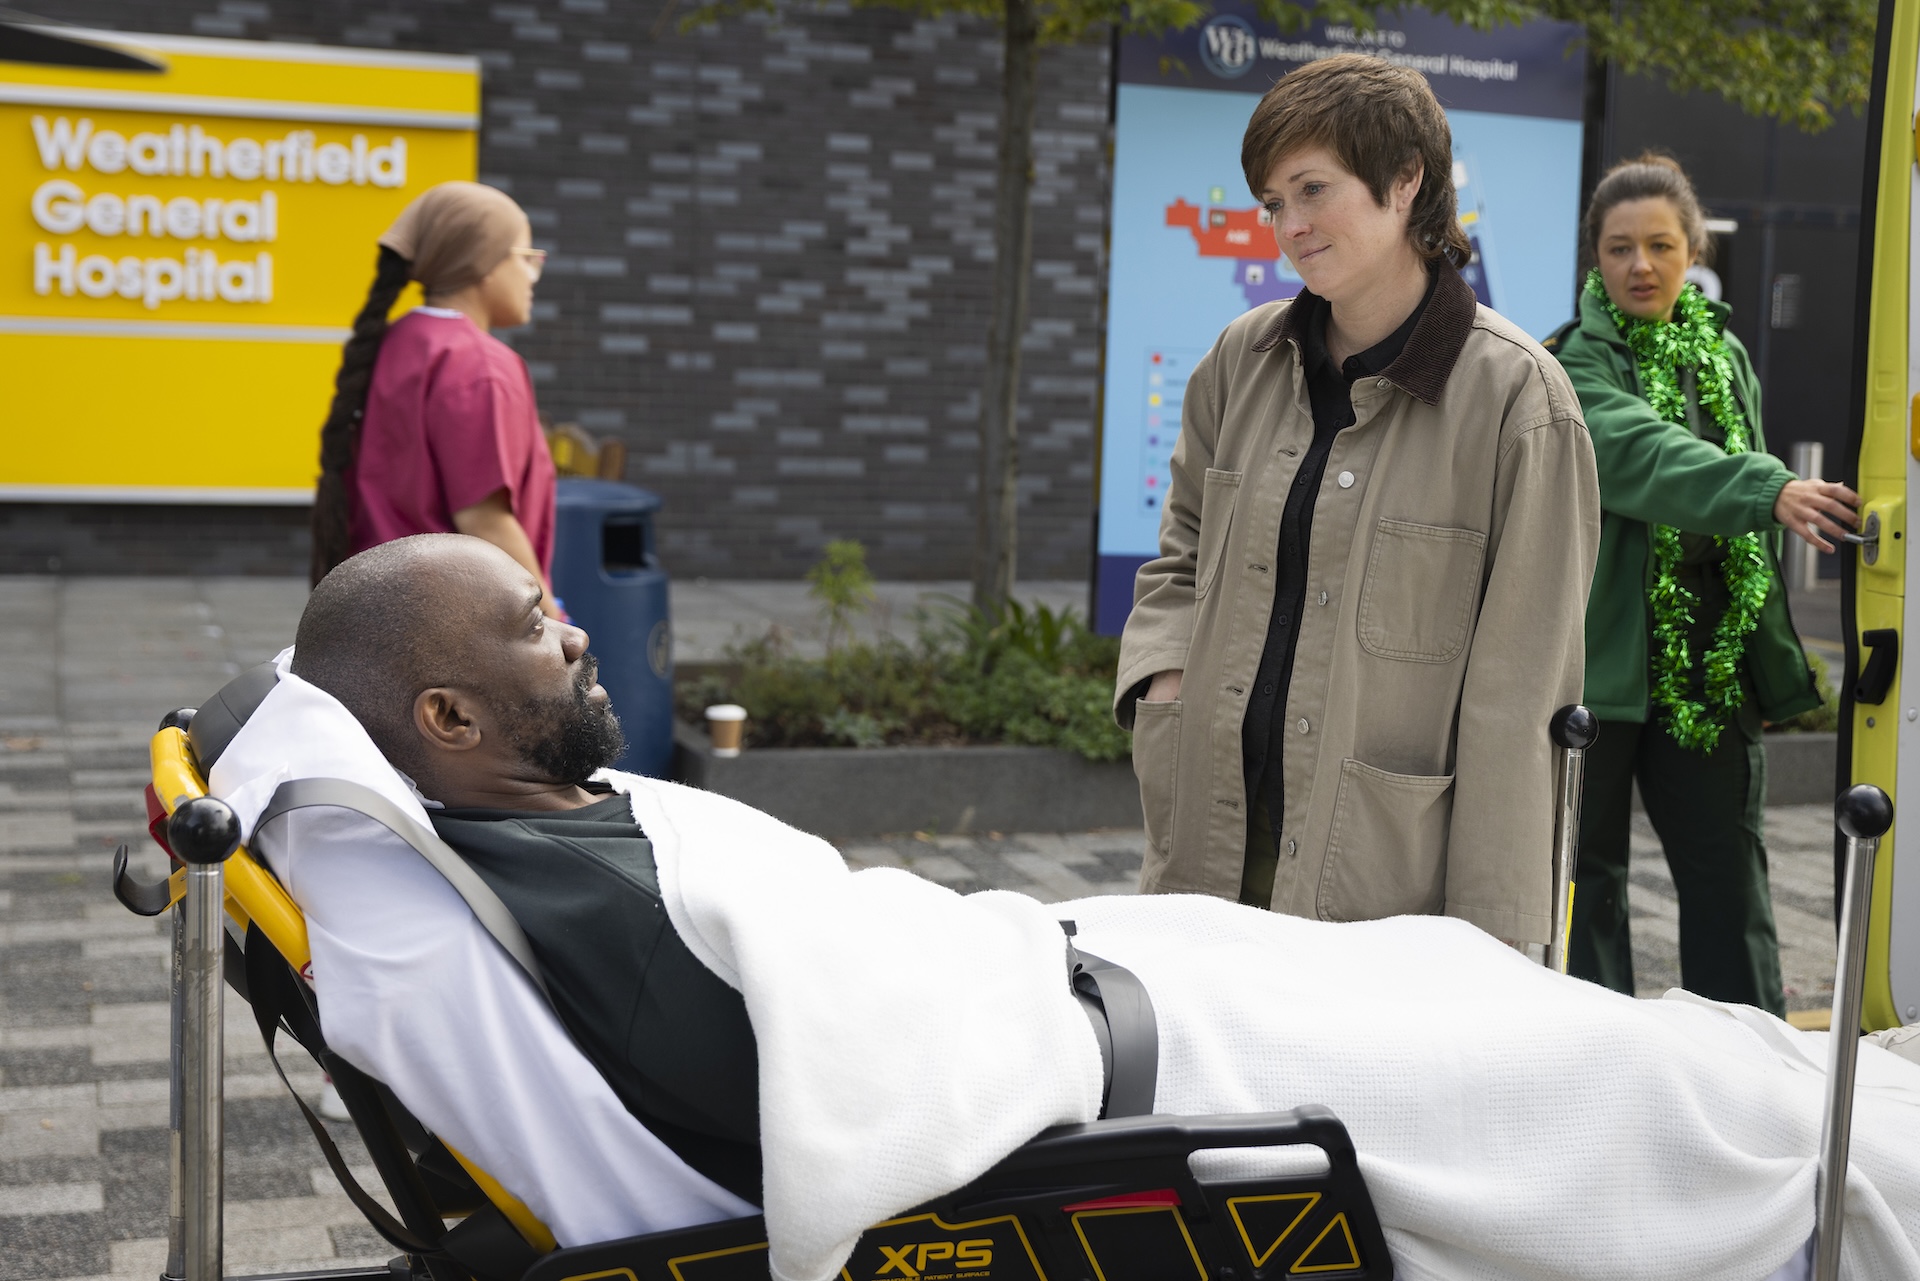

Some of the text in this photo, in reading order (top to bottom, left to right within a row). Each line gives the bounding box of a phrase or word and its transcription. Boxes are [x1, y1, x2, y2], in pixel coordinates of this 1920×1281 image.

[1259, 37, 1376, 62] Weatherf
[1449, 54, 1518, 82] Hospital
[32, 115, 407, 187] Weatherfield
[32, 179, 277, 241] General
[34, 242, 273, 308] Hospital
[875, 1239, 994, 1277] XPS
